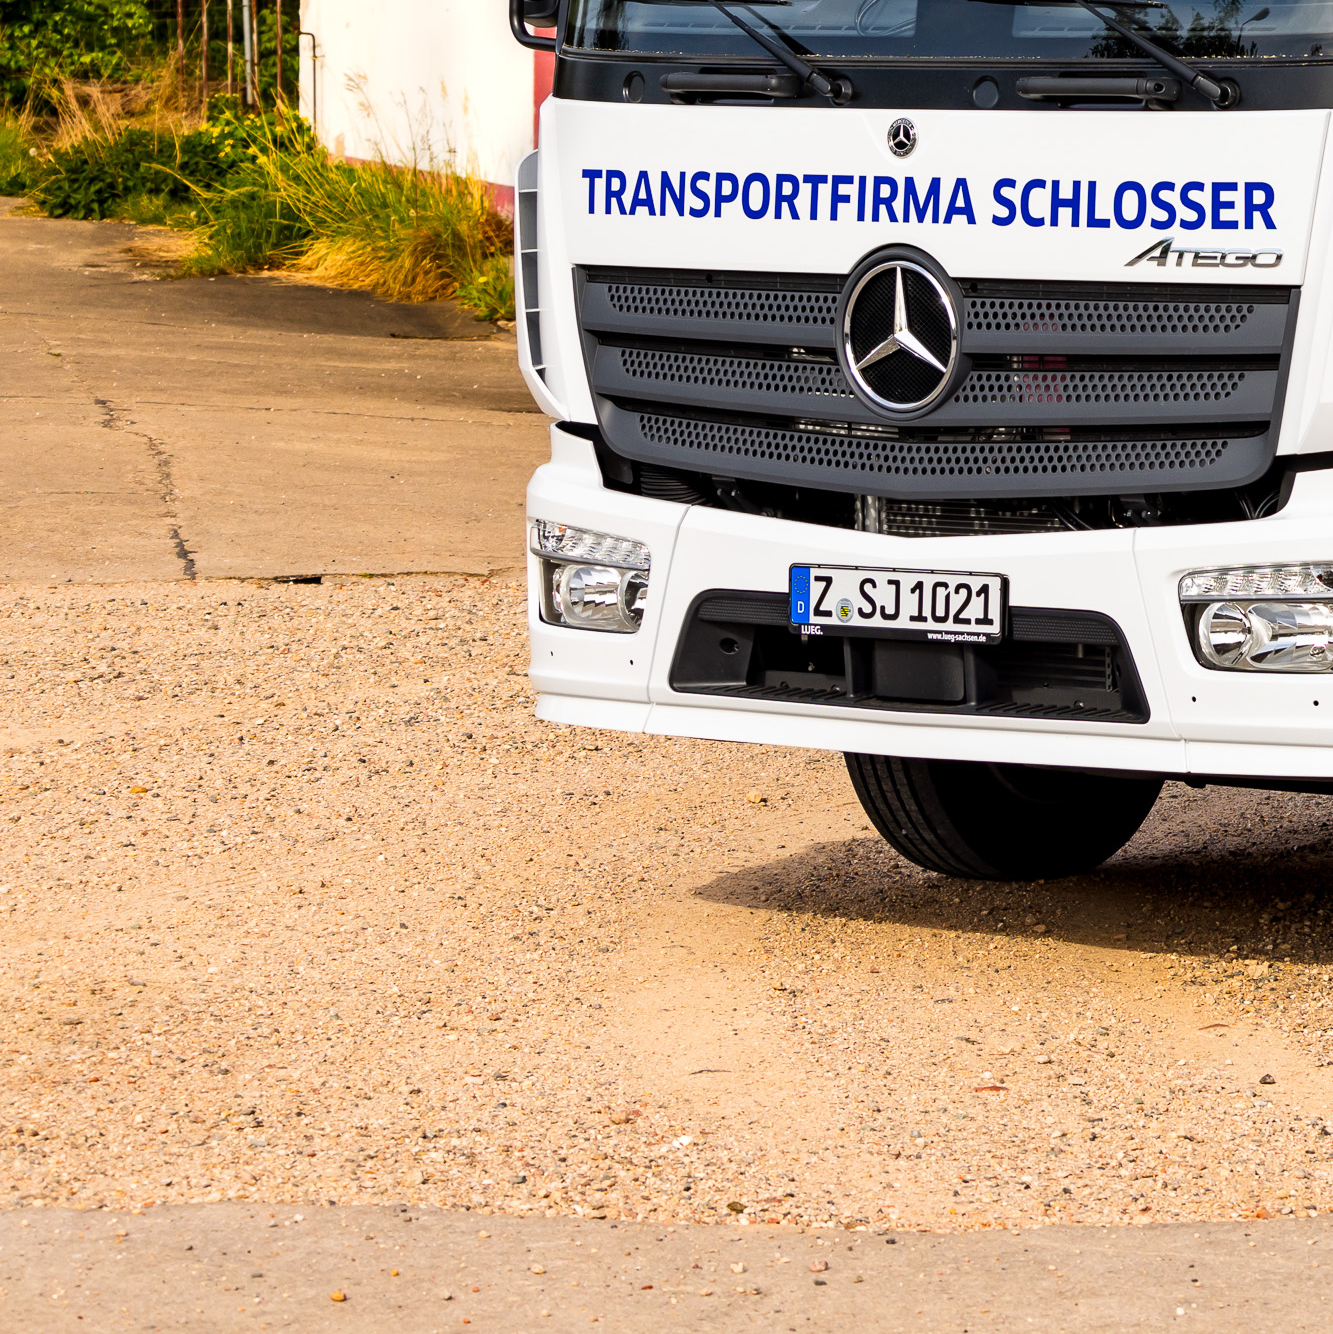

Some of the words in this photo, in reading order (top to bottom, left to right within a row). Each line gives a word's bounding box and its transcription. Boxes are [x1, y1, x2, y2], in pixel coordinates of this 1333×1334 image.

[581, 168, 977, 225] TRANSPORTFIRMA
[991, 177, 1277, 231] SCHLOSSER
[1123, 236, 1285, 268] ATEGO
[797, 600, 805, 614] D
[813, 575, 833, 618] Z
[909, 581, 994, 626] 1021
[927, 631, 987, 643] www.lueg-sachsen.de
